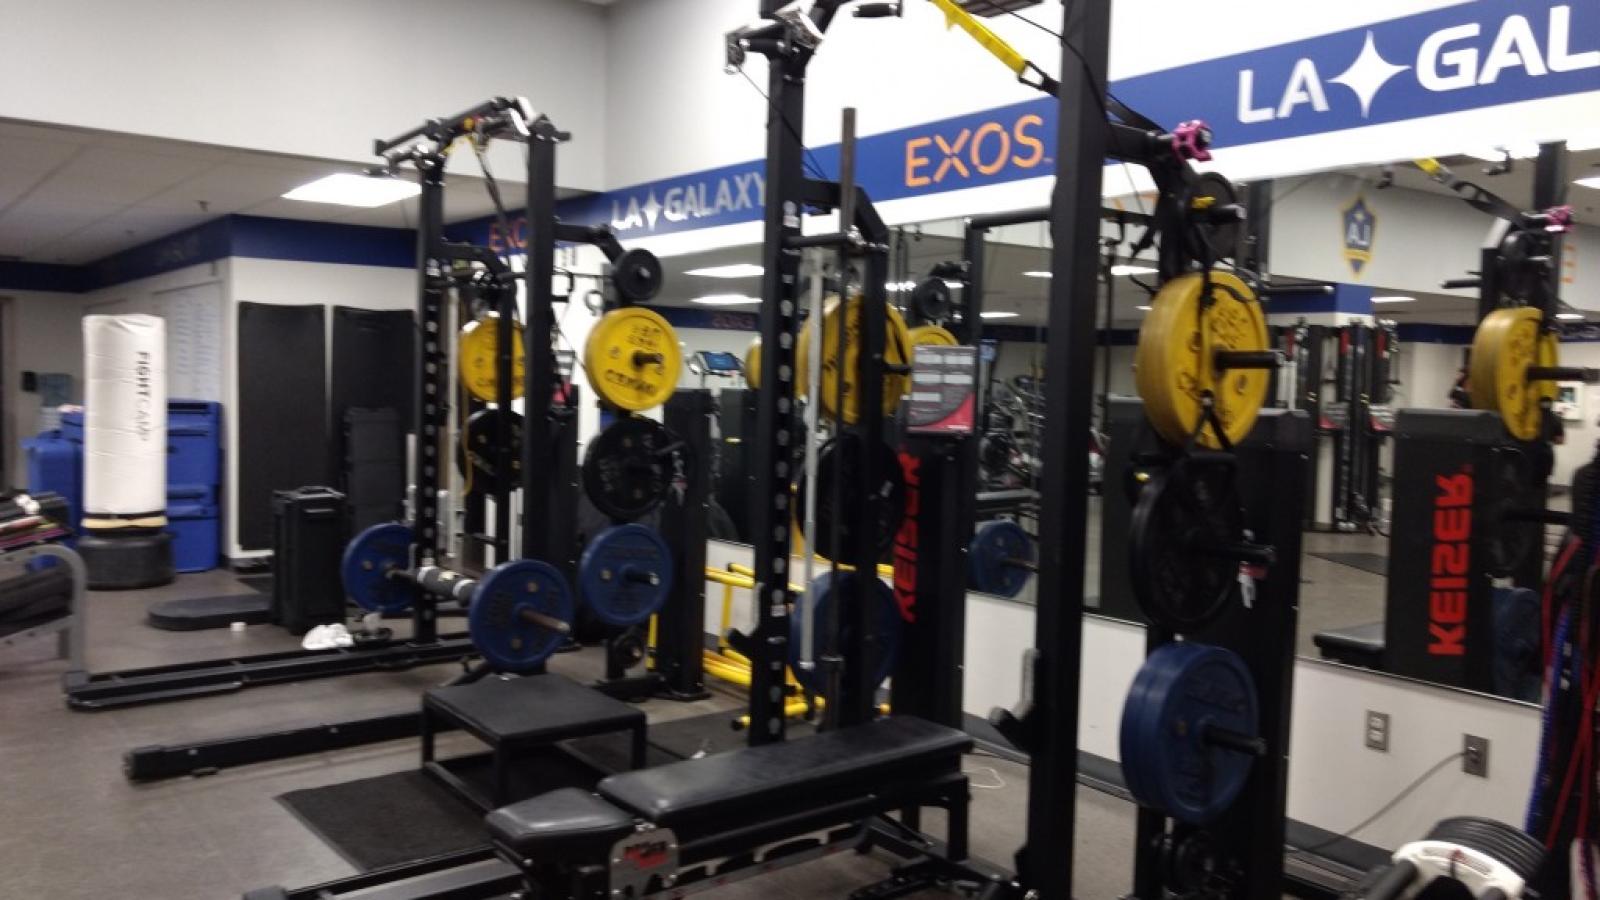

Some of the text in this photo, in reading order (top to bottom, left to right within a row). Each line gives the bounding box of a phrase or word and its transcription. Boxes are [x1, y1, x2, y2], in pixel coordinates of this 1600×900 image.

[1238, 58, 1331, 124] LA
[905, 114, 1044, 187] EXOS
[611, 171, 766, 231] LA GALAXY
